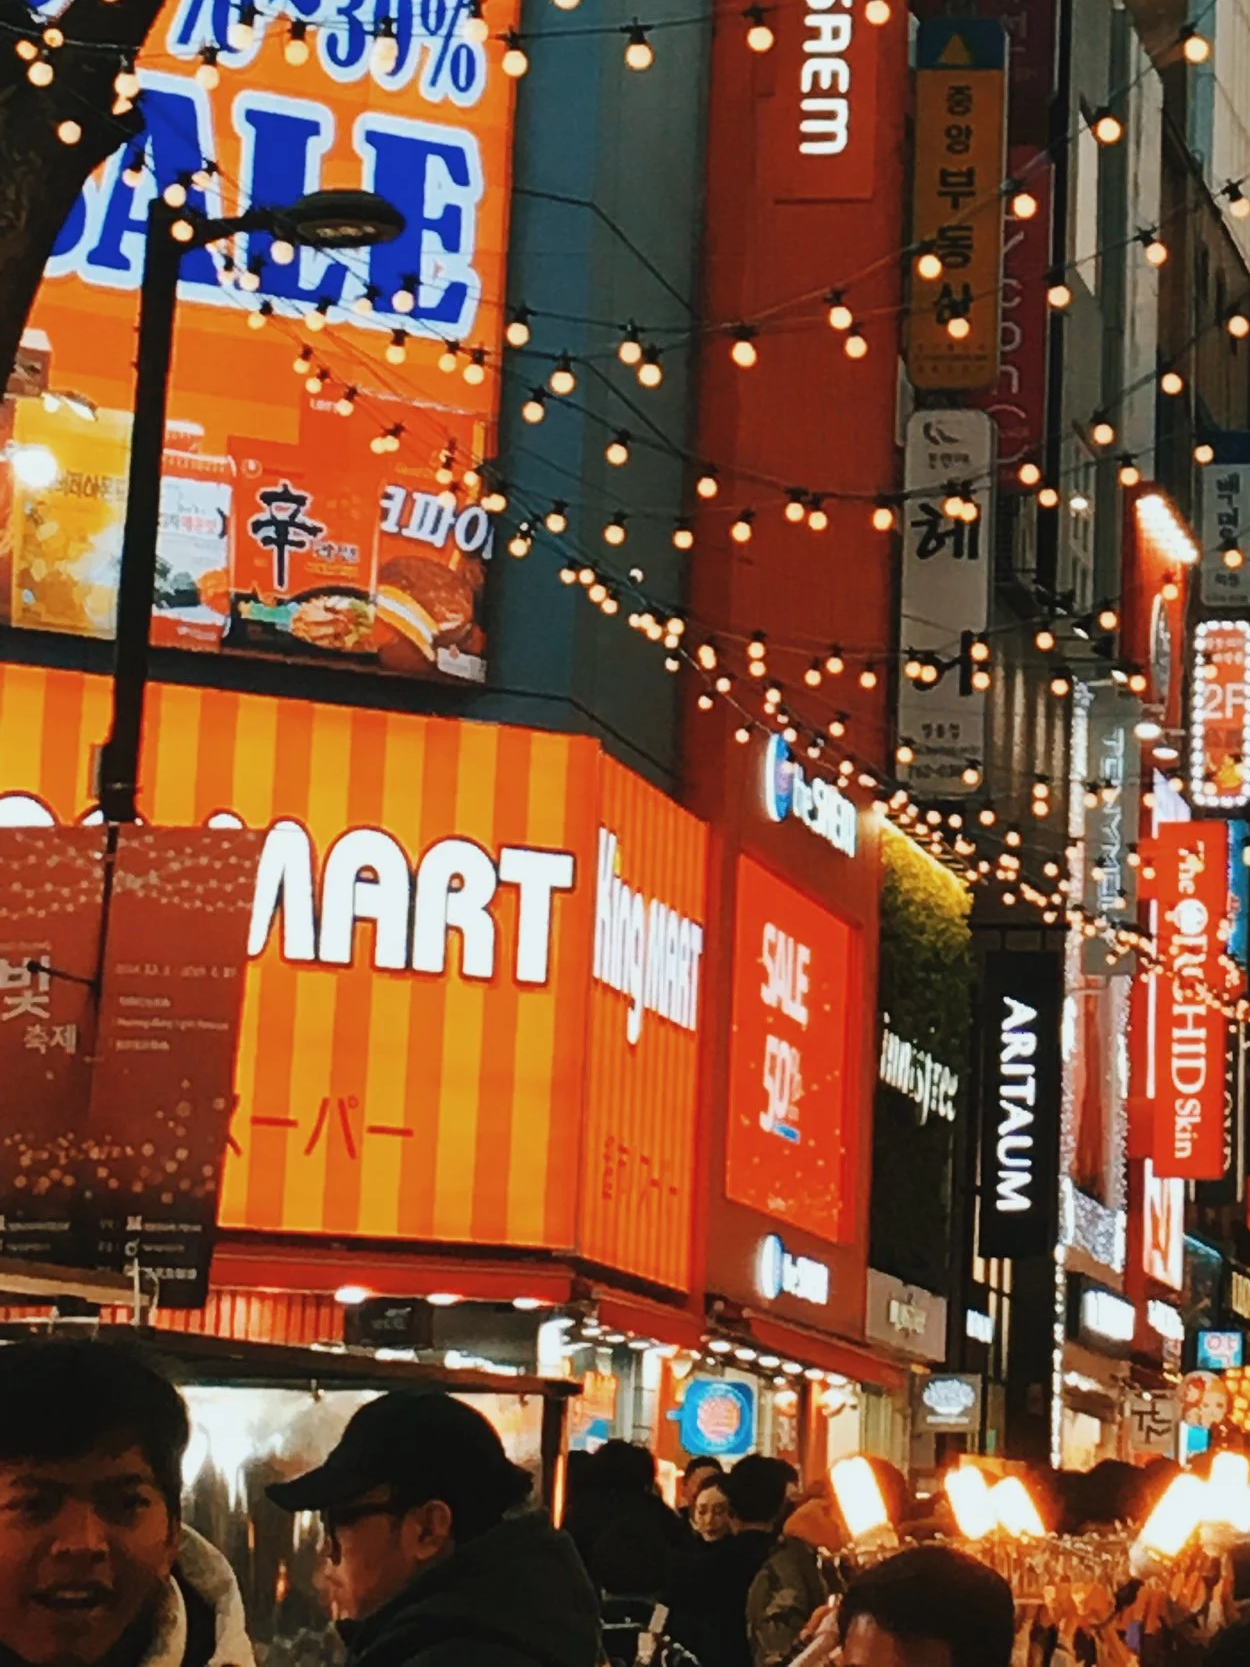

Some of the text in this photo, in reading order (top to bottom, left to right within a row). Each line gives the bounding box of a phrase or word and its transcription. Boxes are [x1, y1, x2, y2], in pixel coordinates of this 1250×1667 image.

[48, 79, 477, 326] ALE
[249, 481, 324, 588] 辛
[760, 921, 811, 1026] SALE
[228, 1095, 414, 1160] ーパー
[996, 996, 1038, 1213] ARITAUM
